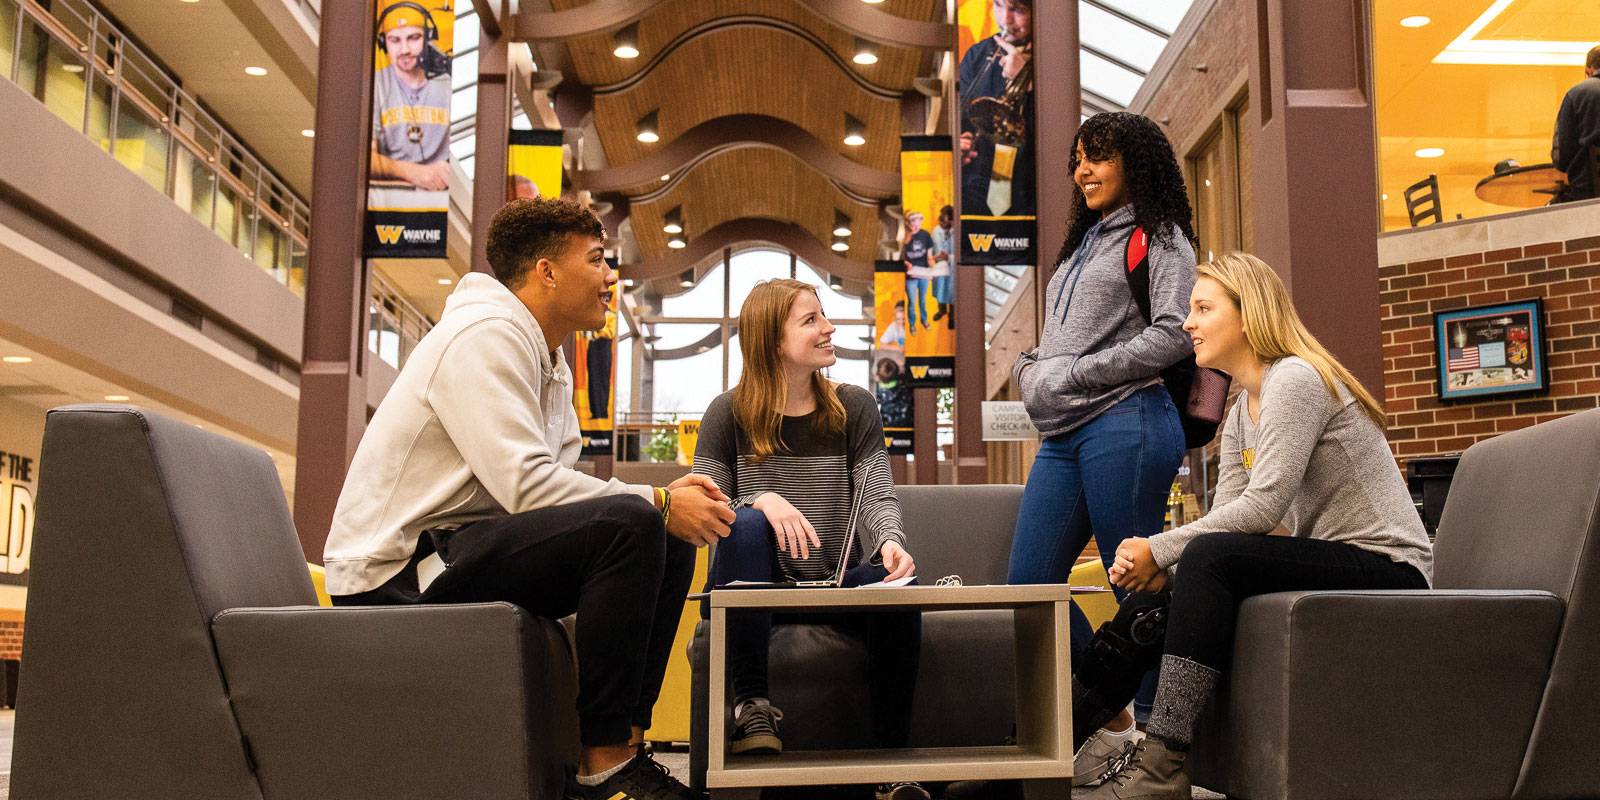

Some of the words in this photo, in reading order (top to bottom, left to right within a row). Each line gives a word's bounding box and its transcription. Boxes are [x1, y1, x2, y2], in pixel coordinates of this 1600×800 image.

[375, 225, 405, 245] W
[403, 229, 441, 240] WAYNE
[968, 234, 996, 253] W
[994, 238, 1029, 248] WAYNE
[990, 422, 1030, 431] CHECK-IN
[993, 413, 1027, 422] VISITOR
[8, 453, 33, 482] THE
